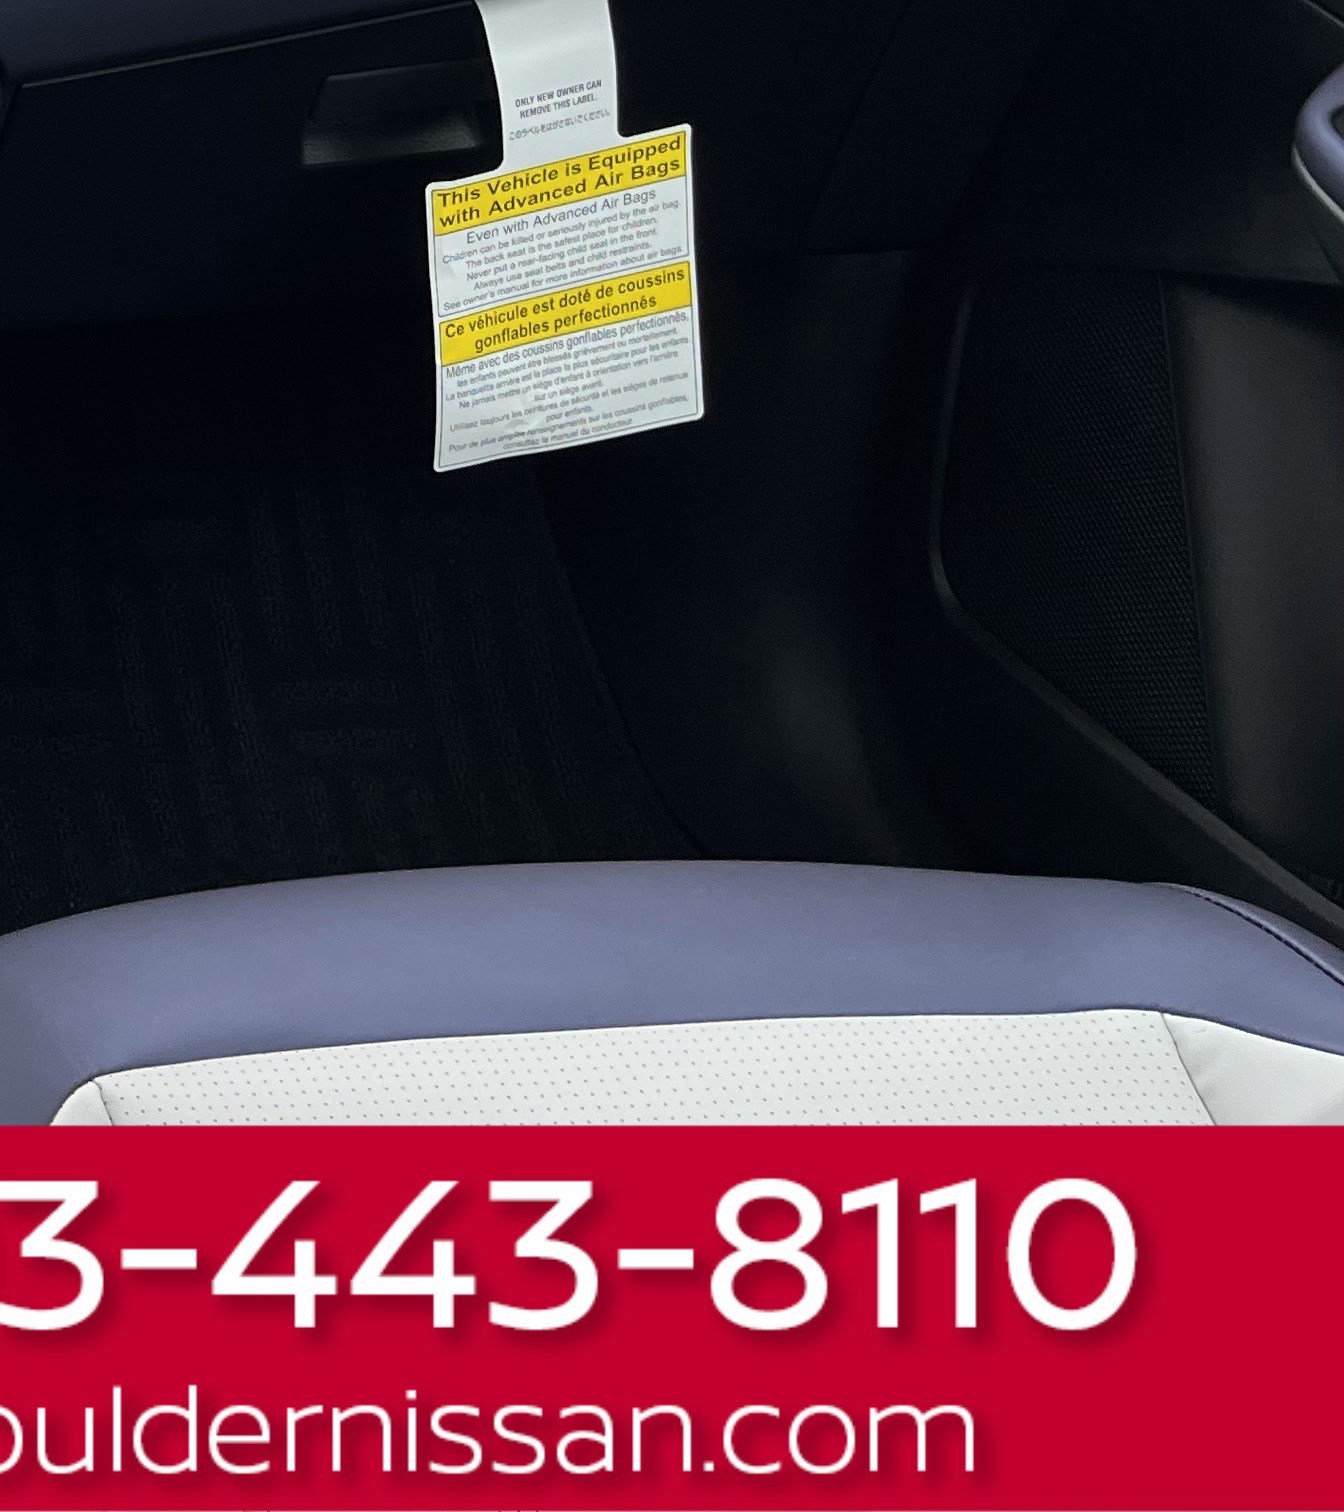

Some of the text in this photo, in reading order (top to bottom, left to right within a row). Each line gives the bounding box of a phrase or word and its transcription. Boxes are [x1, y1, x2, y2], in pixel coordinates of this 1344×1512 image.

[515, 80, 601, 107] ONLY NEW OWNER CAN
[519, 104, 550, 119] REMOVE
[553, 99, 570, 110] THIS
[438, 136, 680, 207] This Vehicle is Equipped
[439, 160, 680, 227] with Advanced Air Bags
[442, 249, 477, 264] Children
[479, 244, 495, 254] can
[497, 241, 509, 249] be
[511, 233, 534, 245] killed
[547, 222, 585, 237] seriously
[587, 213, 617, 228] injured
[619, 212, 629, 221] by
[632, 208, 646, 221] the
[648, 204, 659, 213] air
[661, 200, 681, 210] bag.
[466, 190, 656, 244] Even with Advanced Air Bags
[466, 260, 482, 268] The
[484, 253, 504, 264] back
[507, 248, 526, 258] seat
[537, 242, 552, 251] the
[554, 235, 580, 247] safest
[582, 229, 605, 242] place
[607, 226, 619, 234] for
[621, 218, 658, 231] children.
[466, 269, 491, 281] Never
[493, 264, 507, 275] put
[517, 251, 564, 267] rear-facing
[566, 244, 587, 256] child
[589, 239, 608, 250] seat
[619, 234, 634, 242] the
[636, 228, 658, 238] front.
[473, 242, 651, 290] Always use seat belts and child restraints.
[445, 270, 684, 338] Ce véhicule est doté de coussins
[475, 295, 657, 353] gonflables perfectionnés
[446, 311, 689, 378] Même avec des coussins gonflables perfectionnés,
